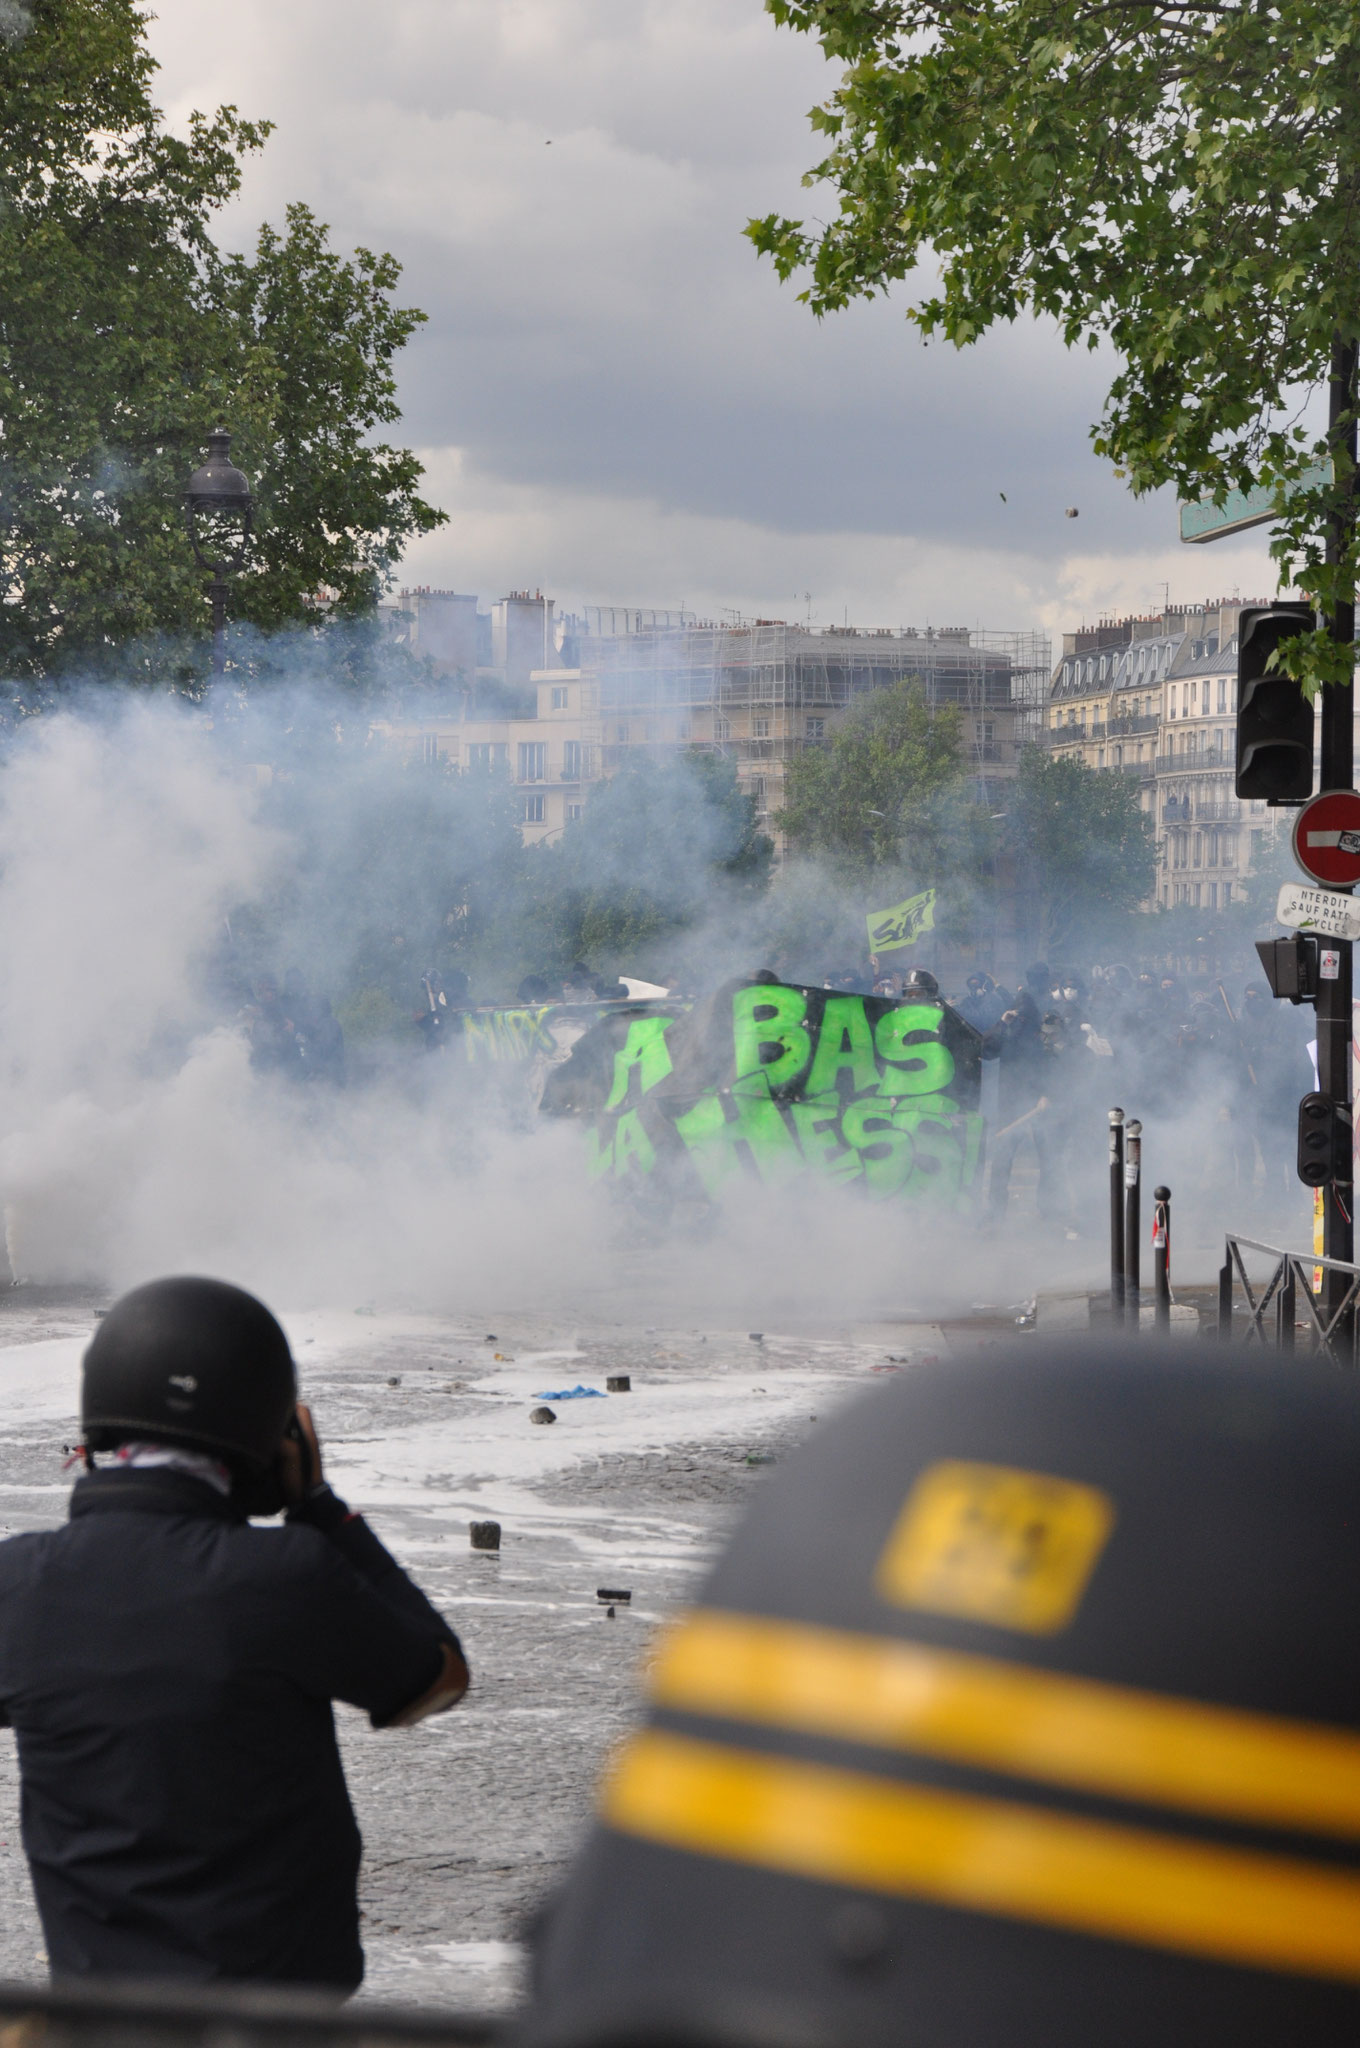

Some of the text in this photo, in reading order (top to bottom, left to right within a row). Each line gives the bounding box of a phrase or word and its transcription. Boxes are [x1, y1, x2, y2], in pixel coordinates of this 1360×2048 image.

[1300, 890, 1349, 909] NTERDIT
[1291, 900, 1351, 921] SAUF RATP
[605, 985, 955, 1110] A BAS
